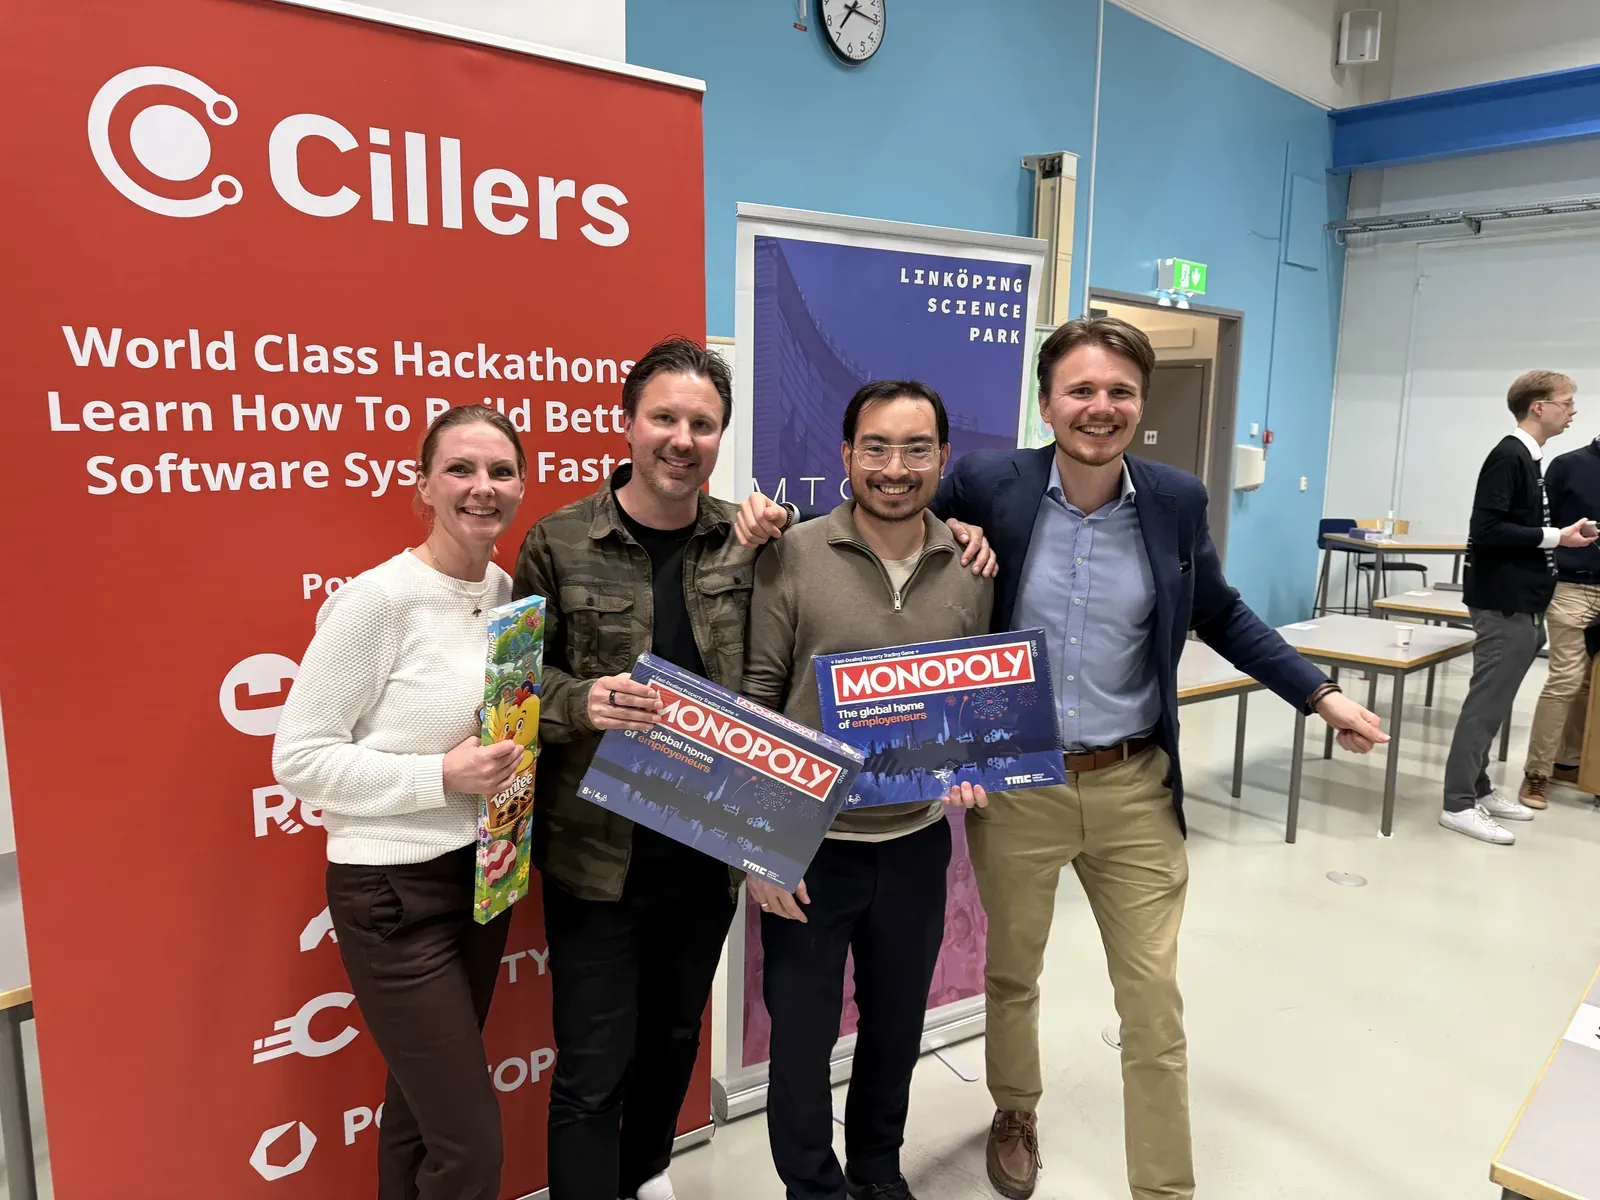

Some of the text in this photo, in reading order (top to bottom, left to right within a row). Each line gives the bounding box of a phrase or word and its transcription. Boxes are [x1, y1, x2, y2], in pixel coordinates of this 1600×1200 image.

[826, 14, 832, 27] 8
[835, 31, 842, 42] 7
[859, 41, 866, 53] 5
[868, 31, 874, 42] 4
[846, 42, 853, 54] 6
[268, 113, 630, 247] Cillers
[900, 267, 1022, 293] LINKÖPING
[927, 297, 1021, 319] SCIENCE
[969, 327, 1020, 344] PARK
[61, 325, 236, 371] World
[254, 333, 379, 374] Class
[47, 391, 213, 432] Learn
[231, 394, 343, 431] How
[355, 396, 411, 432] To
[426, 397, 531, 432] Bld
[86, 452, 330, 496] Software
[302, 573, 353, 600] Po
[863, 653, 884, 662] Property
[884, 651, 901, 659] Trading
[842, 648, 1025, 697] MONOPOLY
[683, 688, 704, 702] Property
[704, 697, 722, 710] Trading
[720, 705, 735, 716] Game
[837, 701, 925, 719] The global home
[838, 711, 928, 730] of employeneurs
[649, 729, 714, 764] global home
[656, 689, 833, 789] MONOPOLY
[624, 729, 712, 774] of employeneurs
[1004, 774, 1032, 785] TMC
[743, 858, 768, 876] TMC
